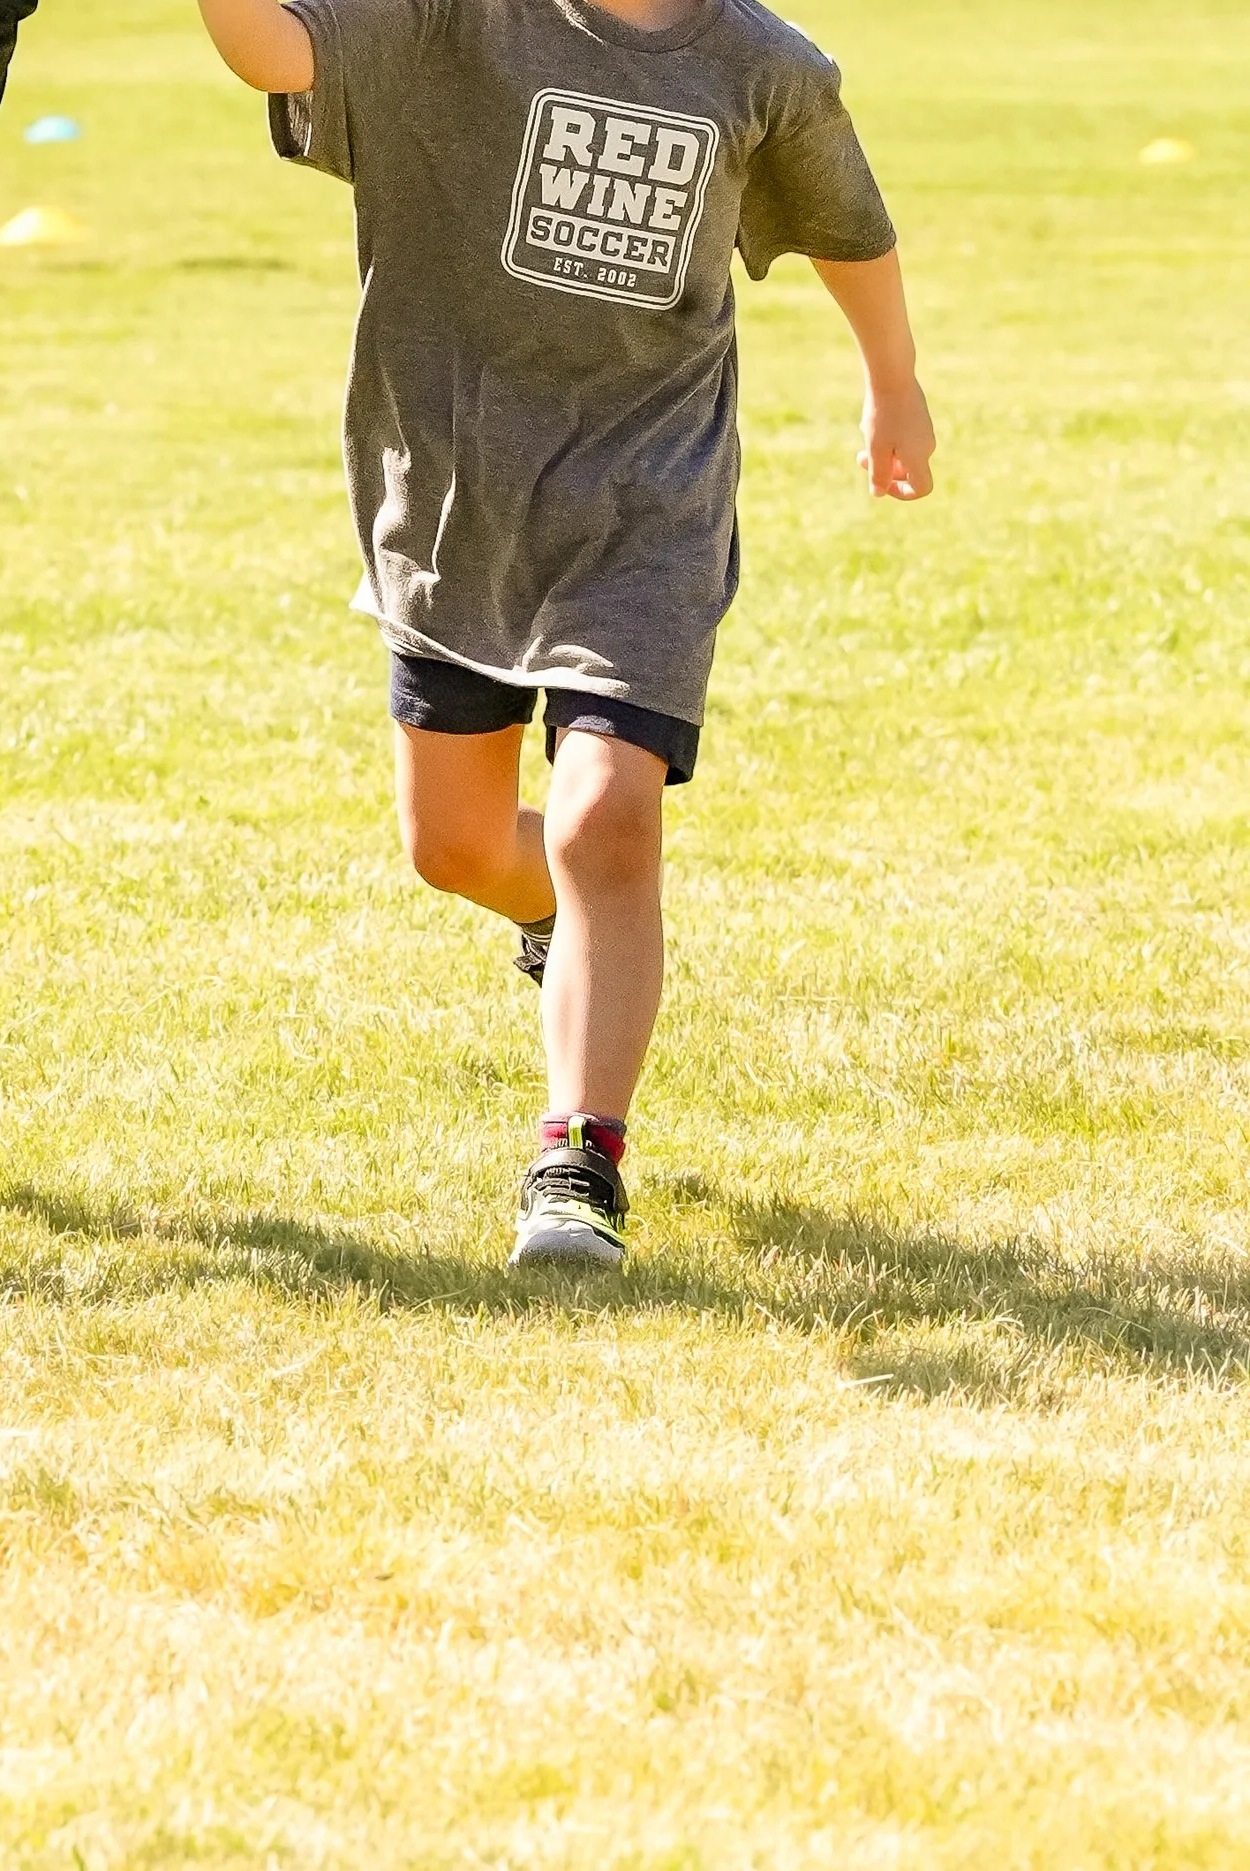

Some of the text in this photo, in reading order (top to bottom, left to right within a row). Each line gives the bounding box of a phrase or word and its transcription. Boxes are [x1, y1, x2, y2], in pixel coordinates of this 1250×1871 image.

[543, 106, 700, 186] RED
[539, 163, 689, 231] WINE
[530, 215, 671, 267] SOCCER
[553, 256, 637, 288] EST. 2002
